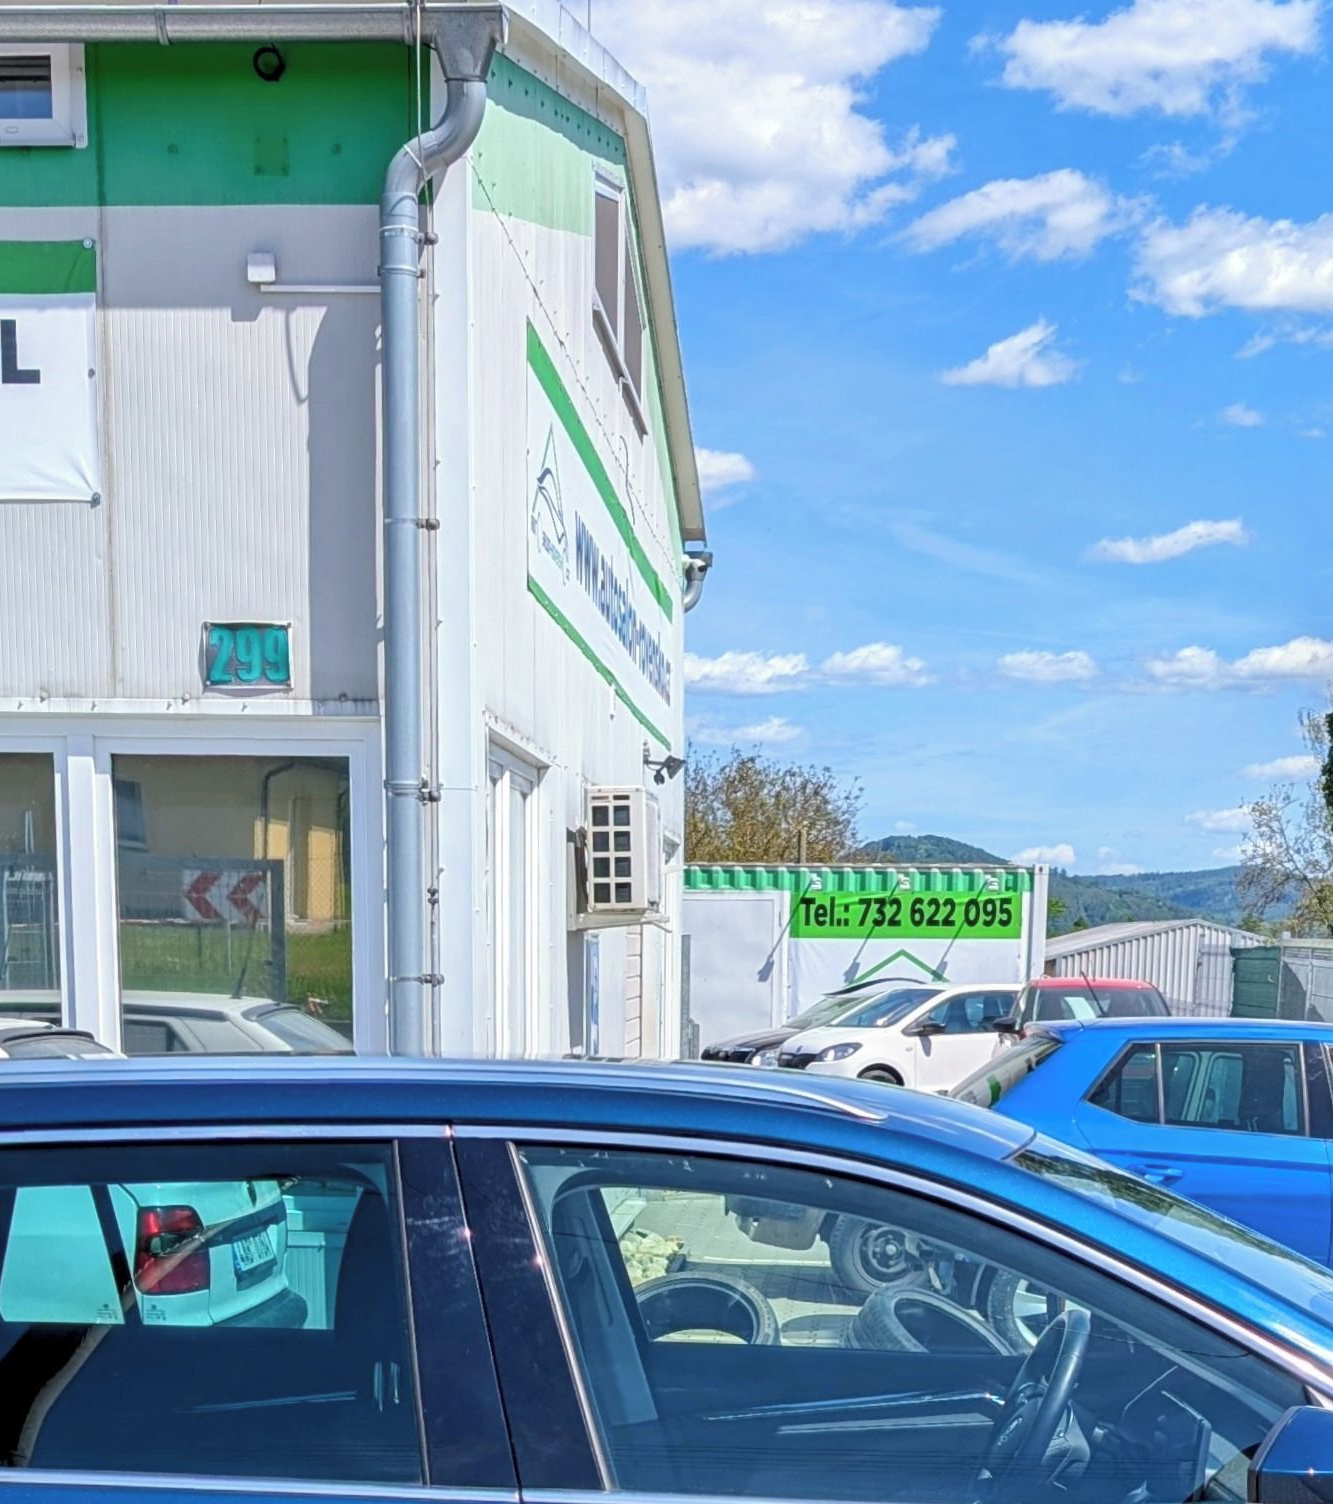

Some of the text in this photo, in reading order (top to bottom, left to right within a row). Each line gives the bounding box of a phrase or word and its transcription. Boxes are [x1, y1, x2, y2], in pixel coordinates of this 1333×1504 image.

[208, 626, 289, 683] 299
[800, 896, 1013, 928] Tel.: 732 622 095
